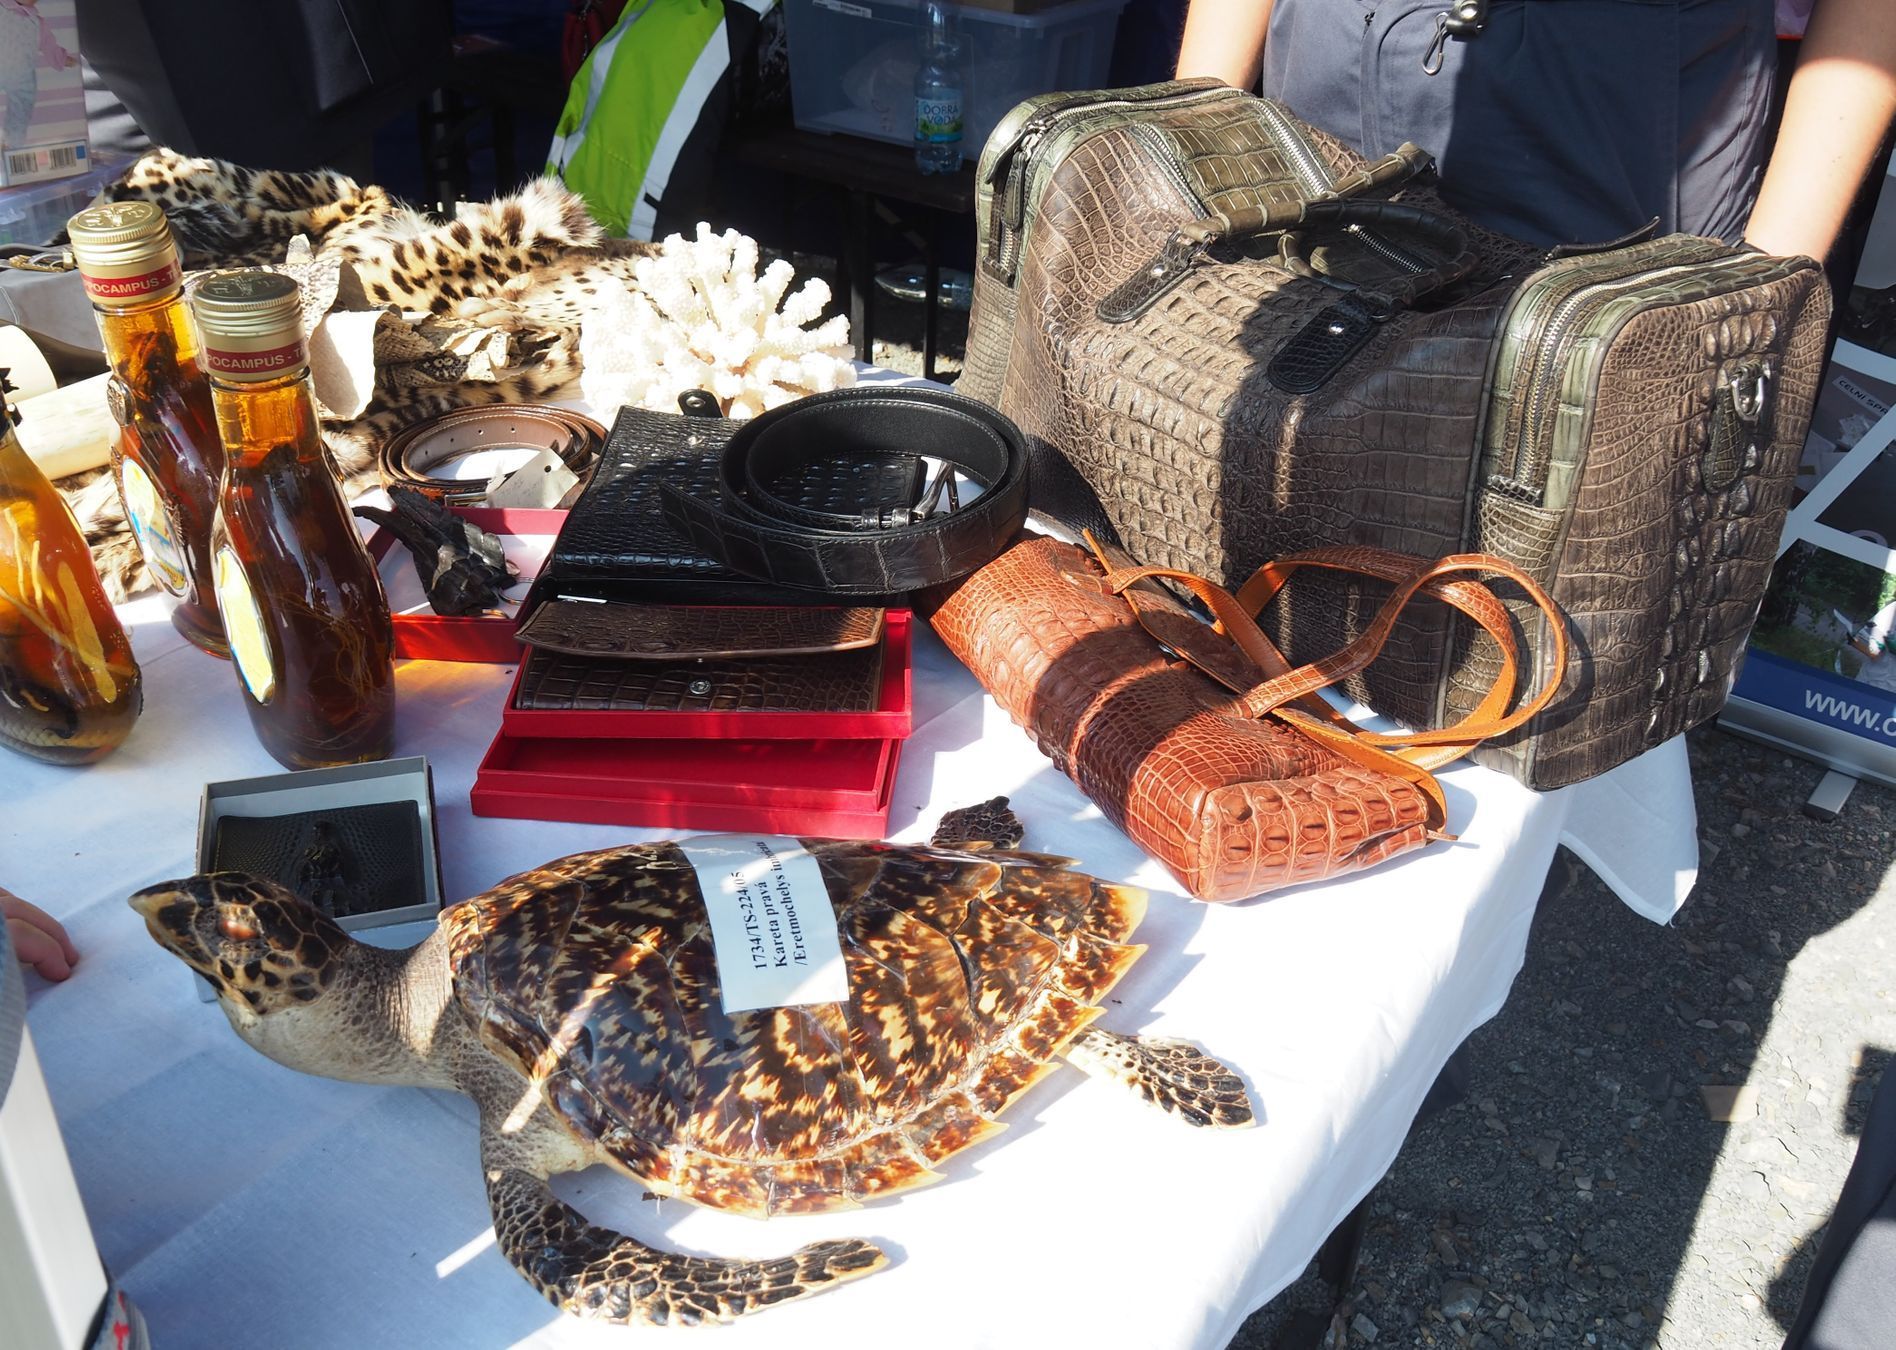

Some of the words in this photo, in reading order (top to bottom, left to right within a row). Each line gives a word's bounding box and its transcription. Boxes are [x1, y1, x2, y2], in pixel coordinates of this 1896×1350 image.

[730, 871, 768, 970] 1734/TS-224/05
[754, 880, 780, 917] pravá
[775, 873, 809, 967] /Eretmochelys
[768, 919, 788, 968] Kareta
